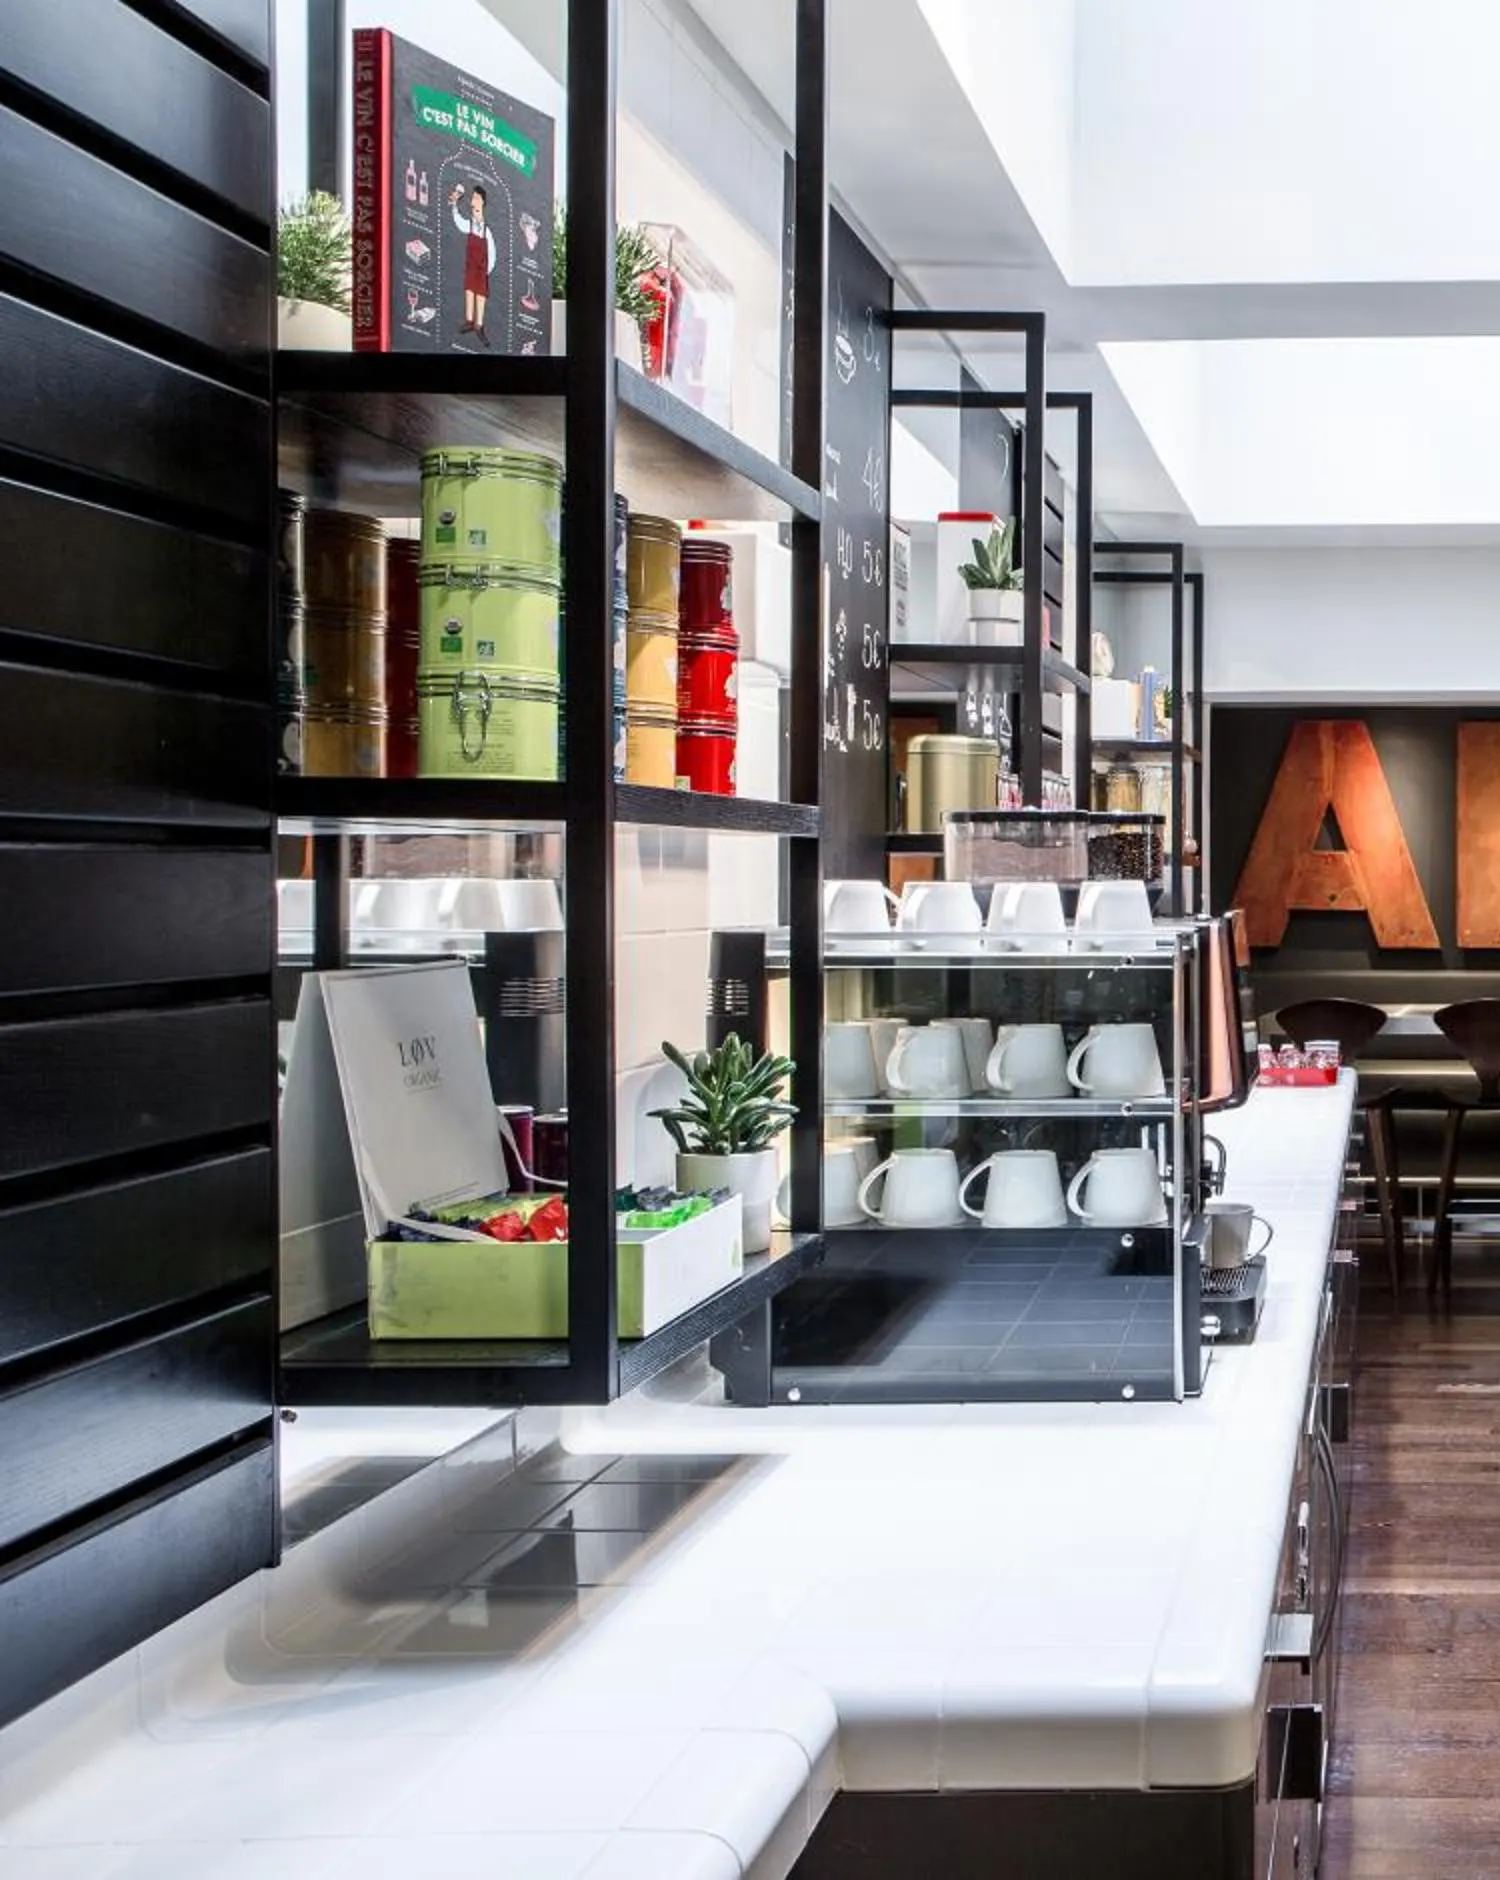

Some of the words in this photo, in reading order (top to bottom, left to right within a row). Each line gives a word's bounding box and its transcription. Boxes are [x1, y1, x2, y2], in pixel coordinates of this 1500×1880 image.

[356, 60, 375, 81] LE
[356, 88, 375, 127] VIN
[456, 102, 470, 119] LE
[473, 109, 496, 131] VIN
[422, 106, 454, 129] C'EST
[456, 118, 478, 139] PAS
[480, 129, 526, 168] SORCIER
[356, 195, 374, 233] PAS
